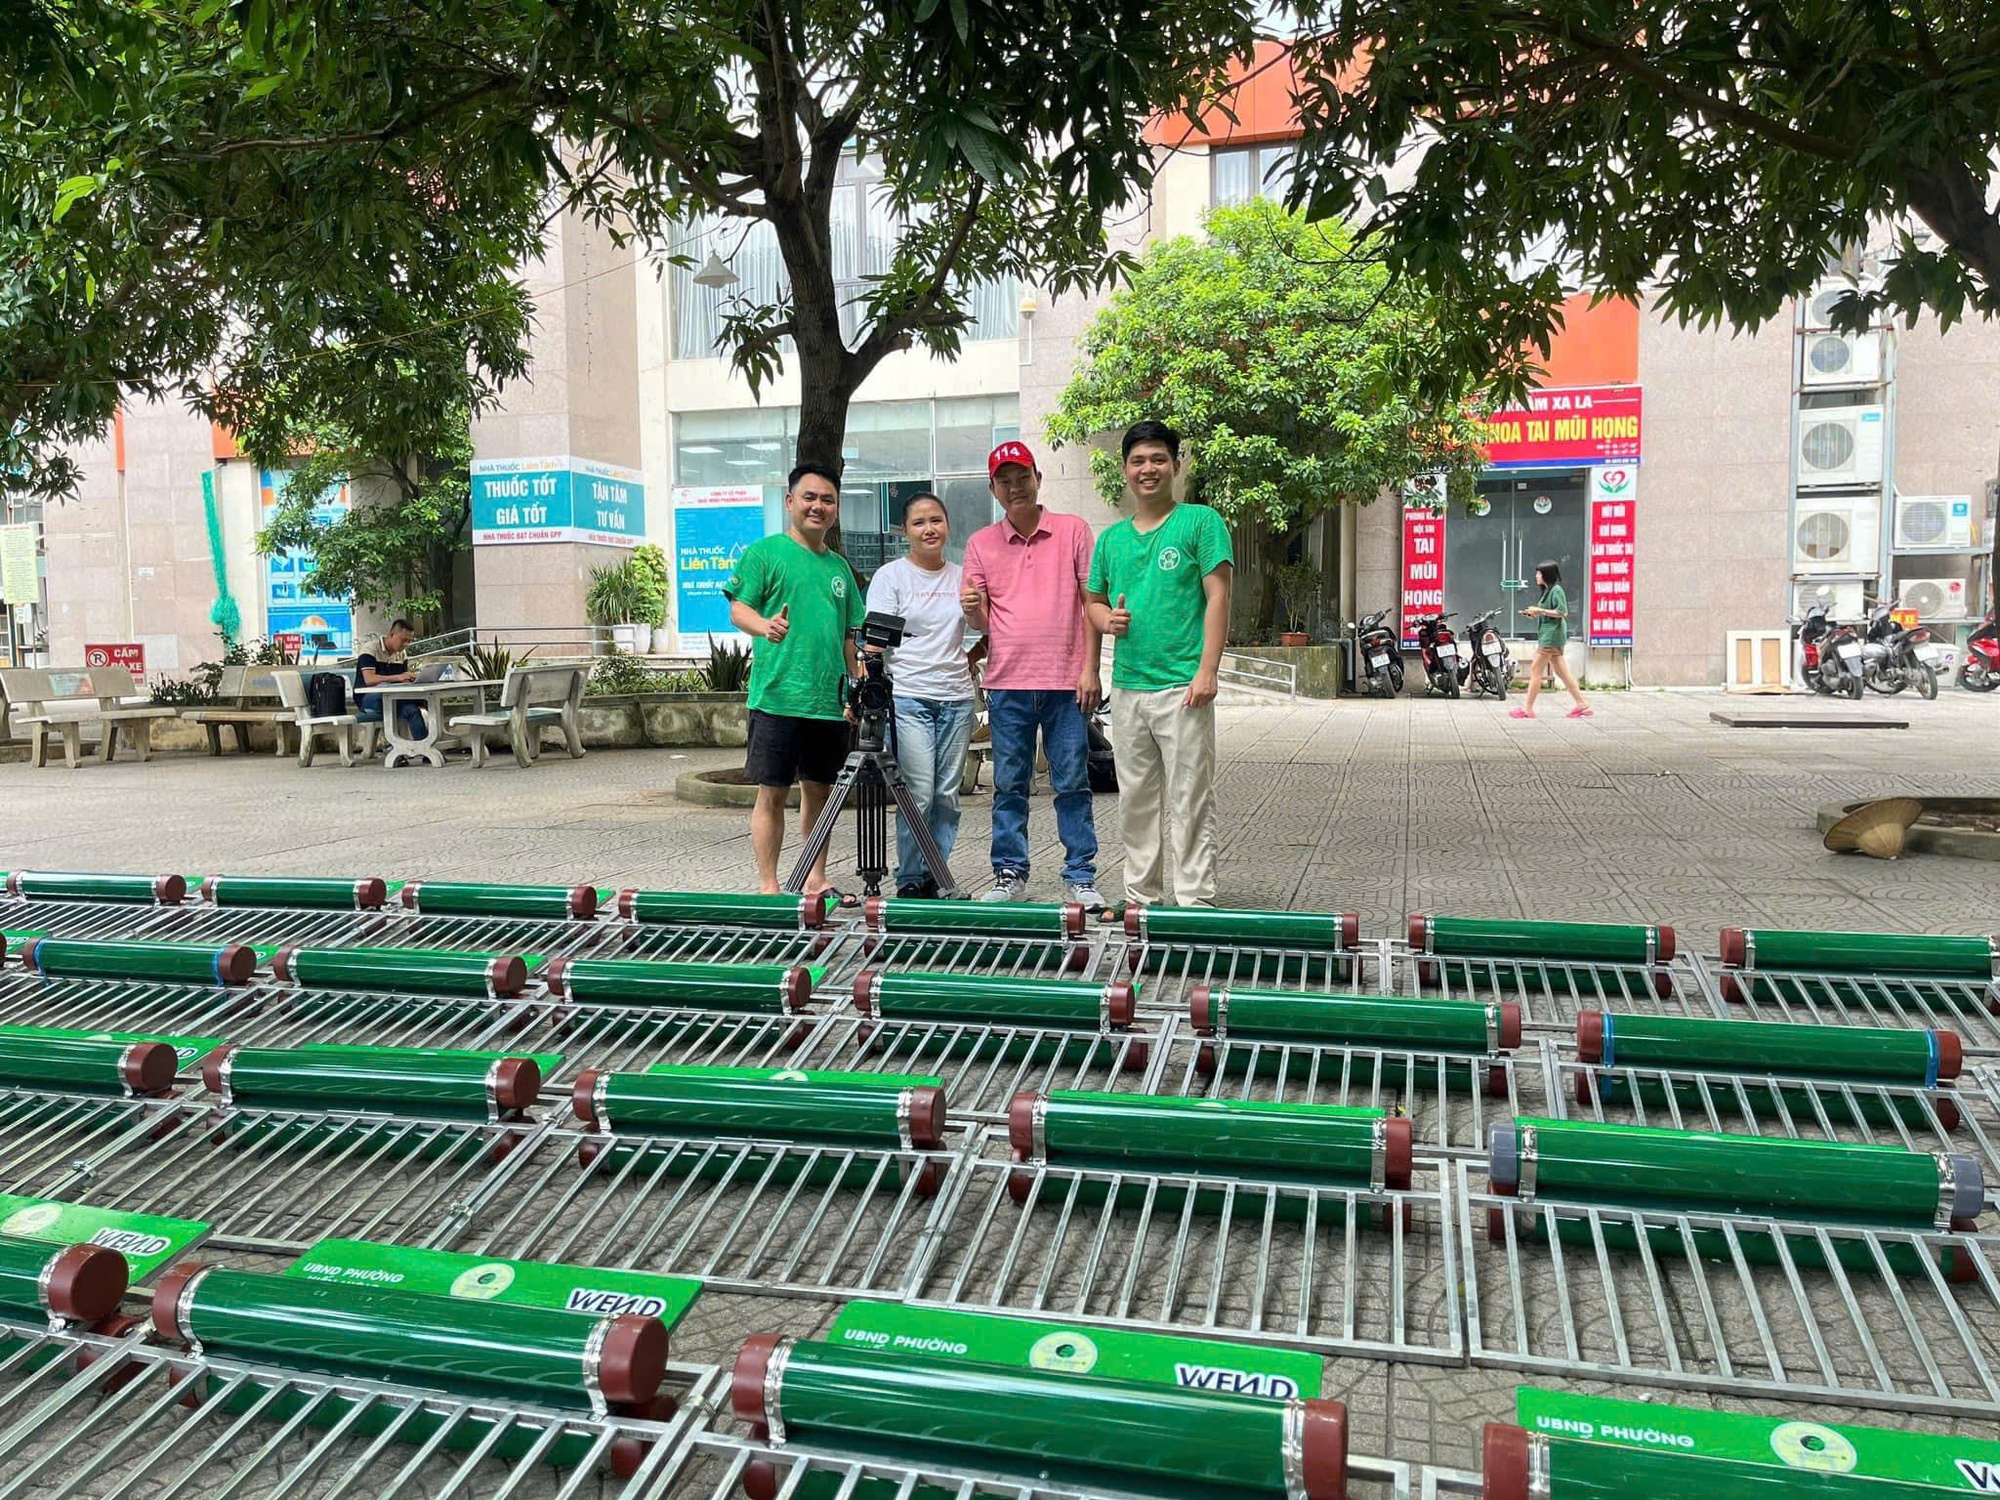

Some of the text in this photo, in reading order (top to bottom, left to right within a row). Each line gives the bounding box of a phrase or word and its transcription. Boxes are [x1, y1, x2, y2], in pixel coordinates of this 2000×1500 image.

[1552, 396, 1572, 411] XA
[1575, 394, 1593, 409] LA
[1479, 414, 1638, 444] HOA TAI MŨI HỌNG
[995, 446, 1020, 460] 114
[484, 472, 557, 498] THUỐC TỐT
[609, 483, 627, 505] TÂM
[496, 501, 547, 525] GIÁ TỐT
[1413, 538, 1435, 554] TAI
[1410, 560, 1437, 579] MŨI
[1404, 590, 1442, 609] HỌNG
[129, 662, 143, 671] XE
[303, 1262, 342, 1276] UBND
[844, 1328, 890, 1345] UBND
[1537, 1415, 1594, 1434] UBND
